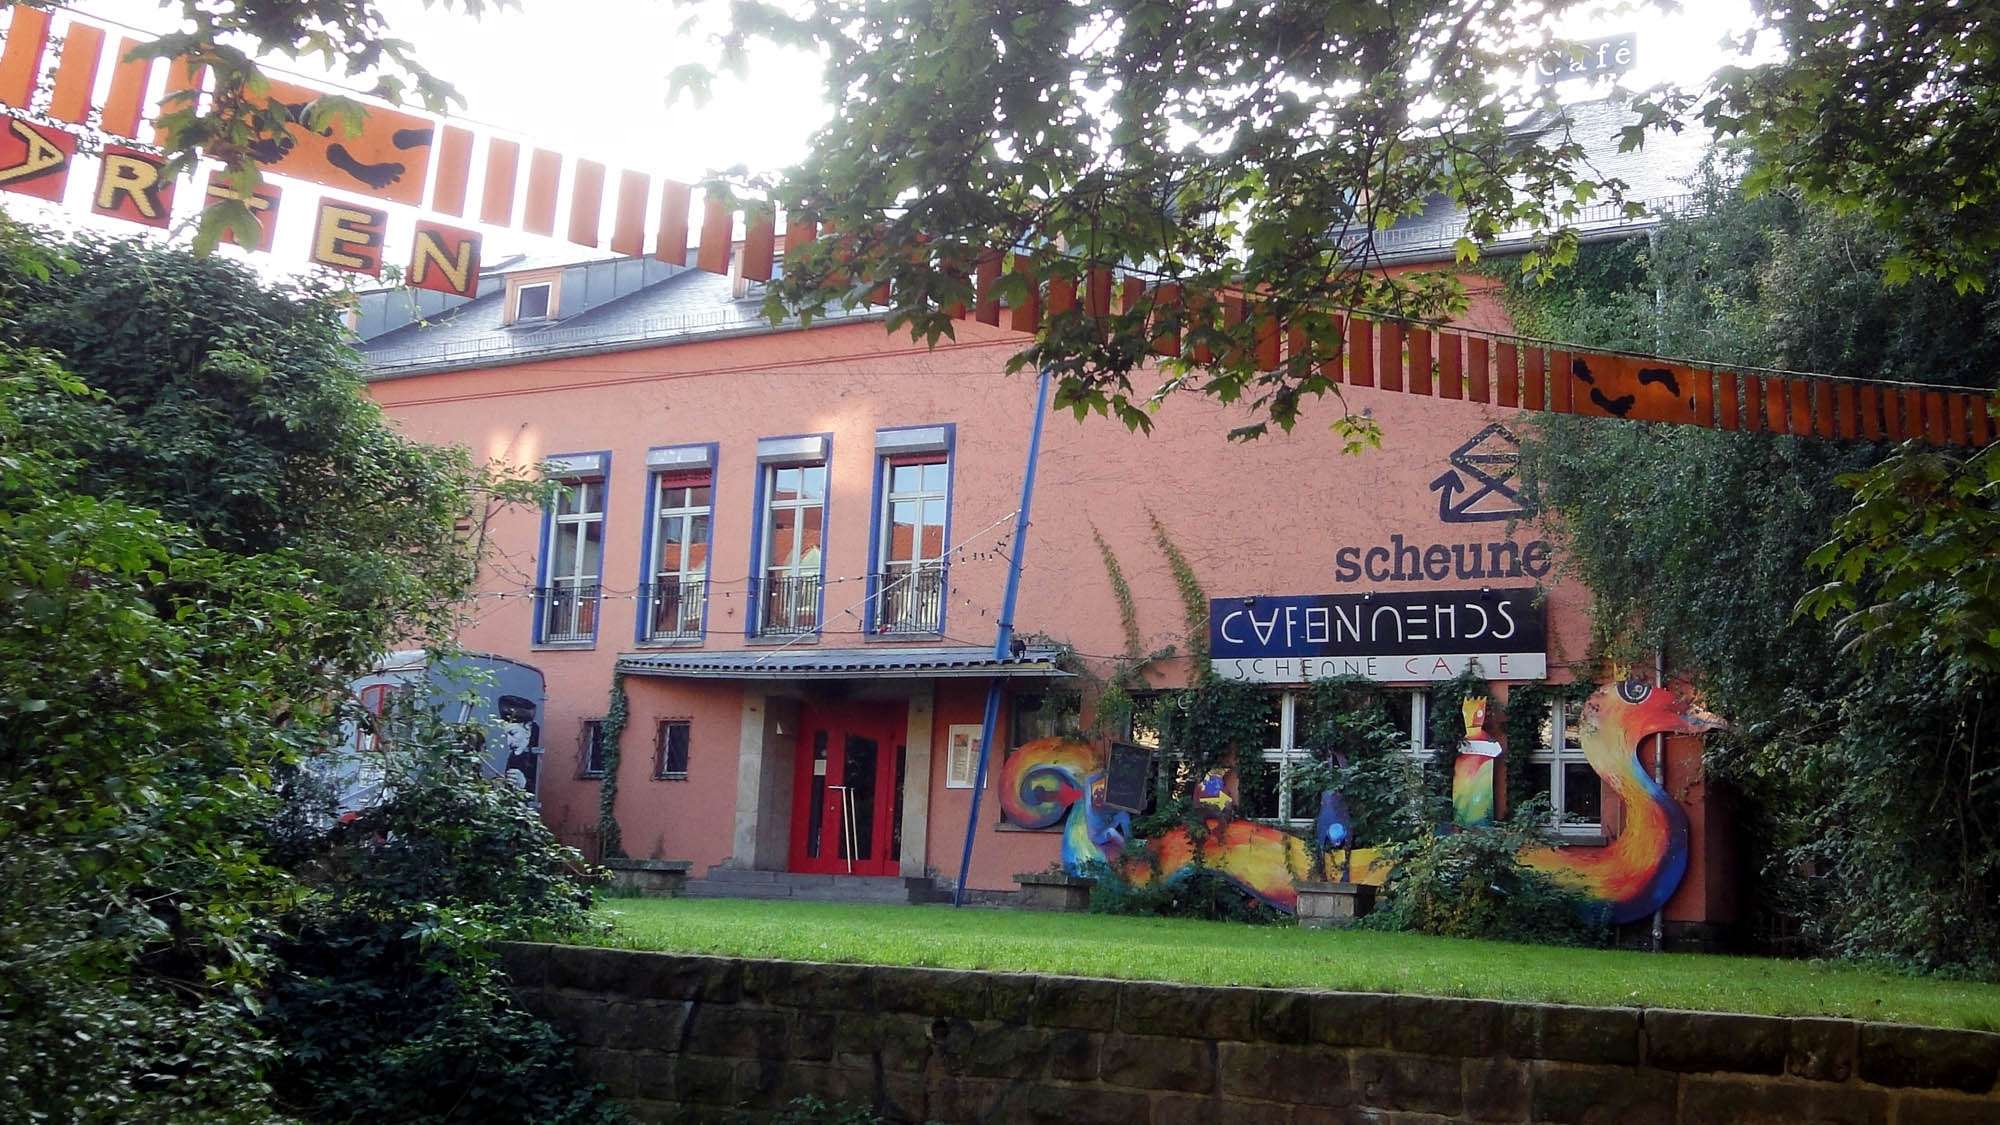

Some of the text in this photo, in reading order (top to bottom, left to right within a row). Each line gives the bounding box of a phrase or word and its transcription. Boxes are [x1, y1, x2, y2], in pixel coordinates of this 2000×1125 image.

[1537, 39, 1632, 76] Café
[1335, 534, 1552, 582] scheune
[1405, 655, 1509, 675] CAFE
